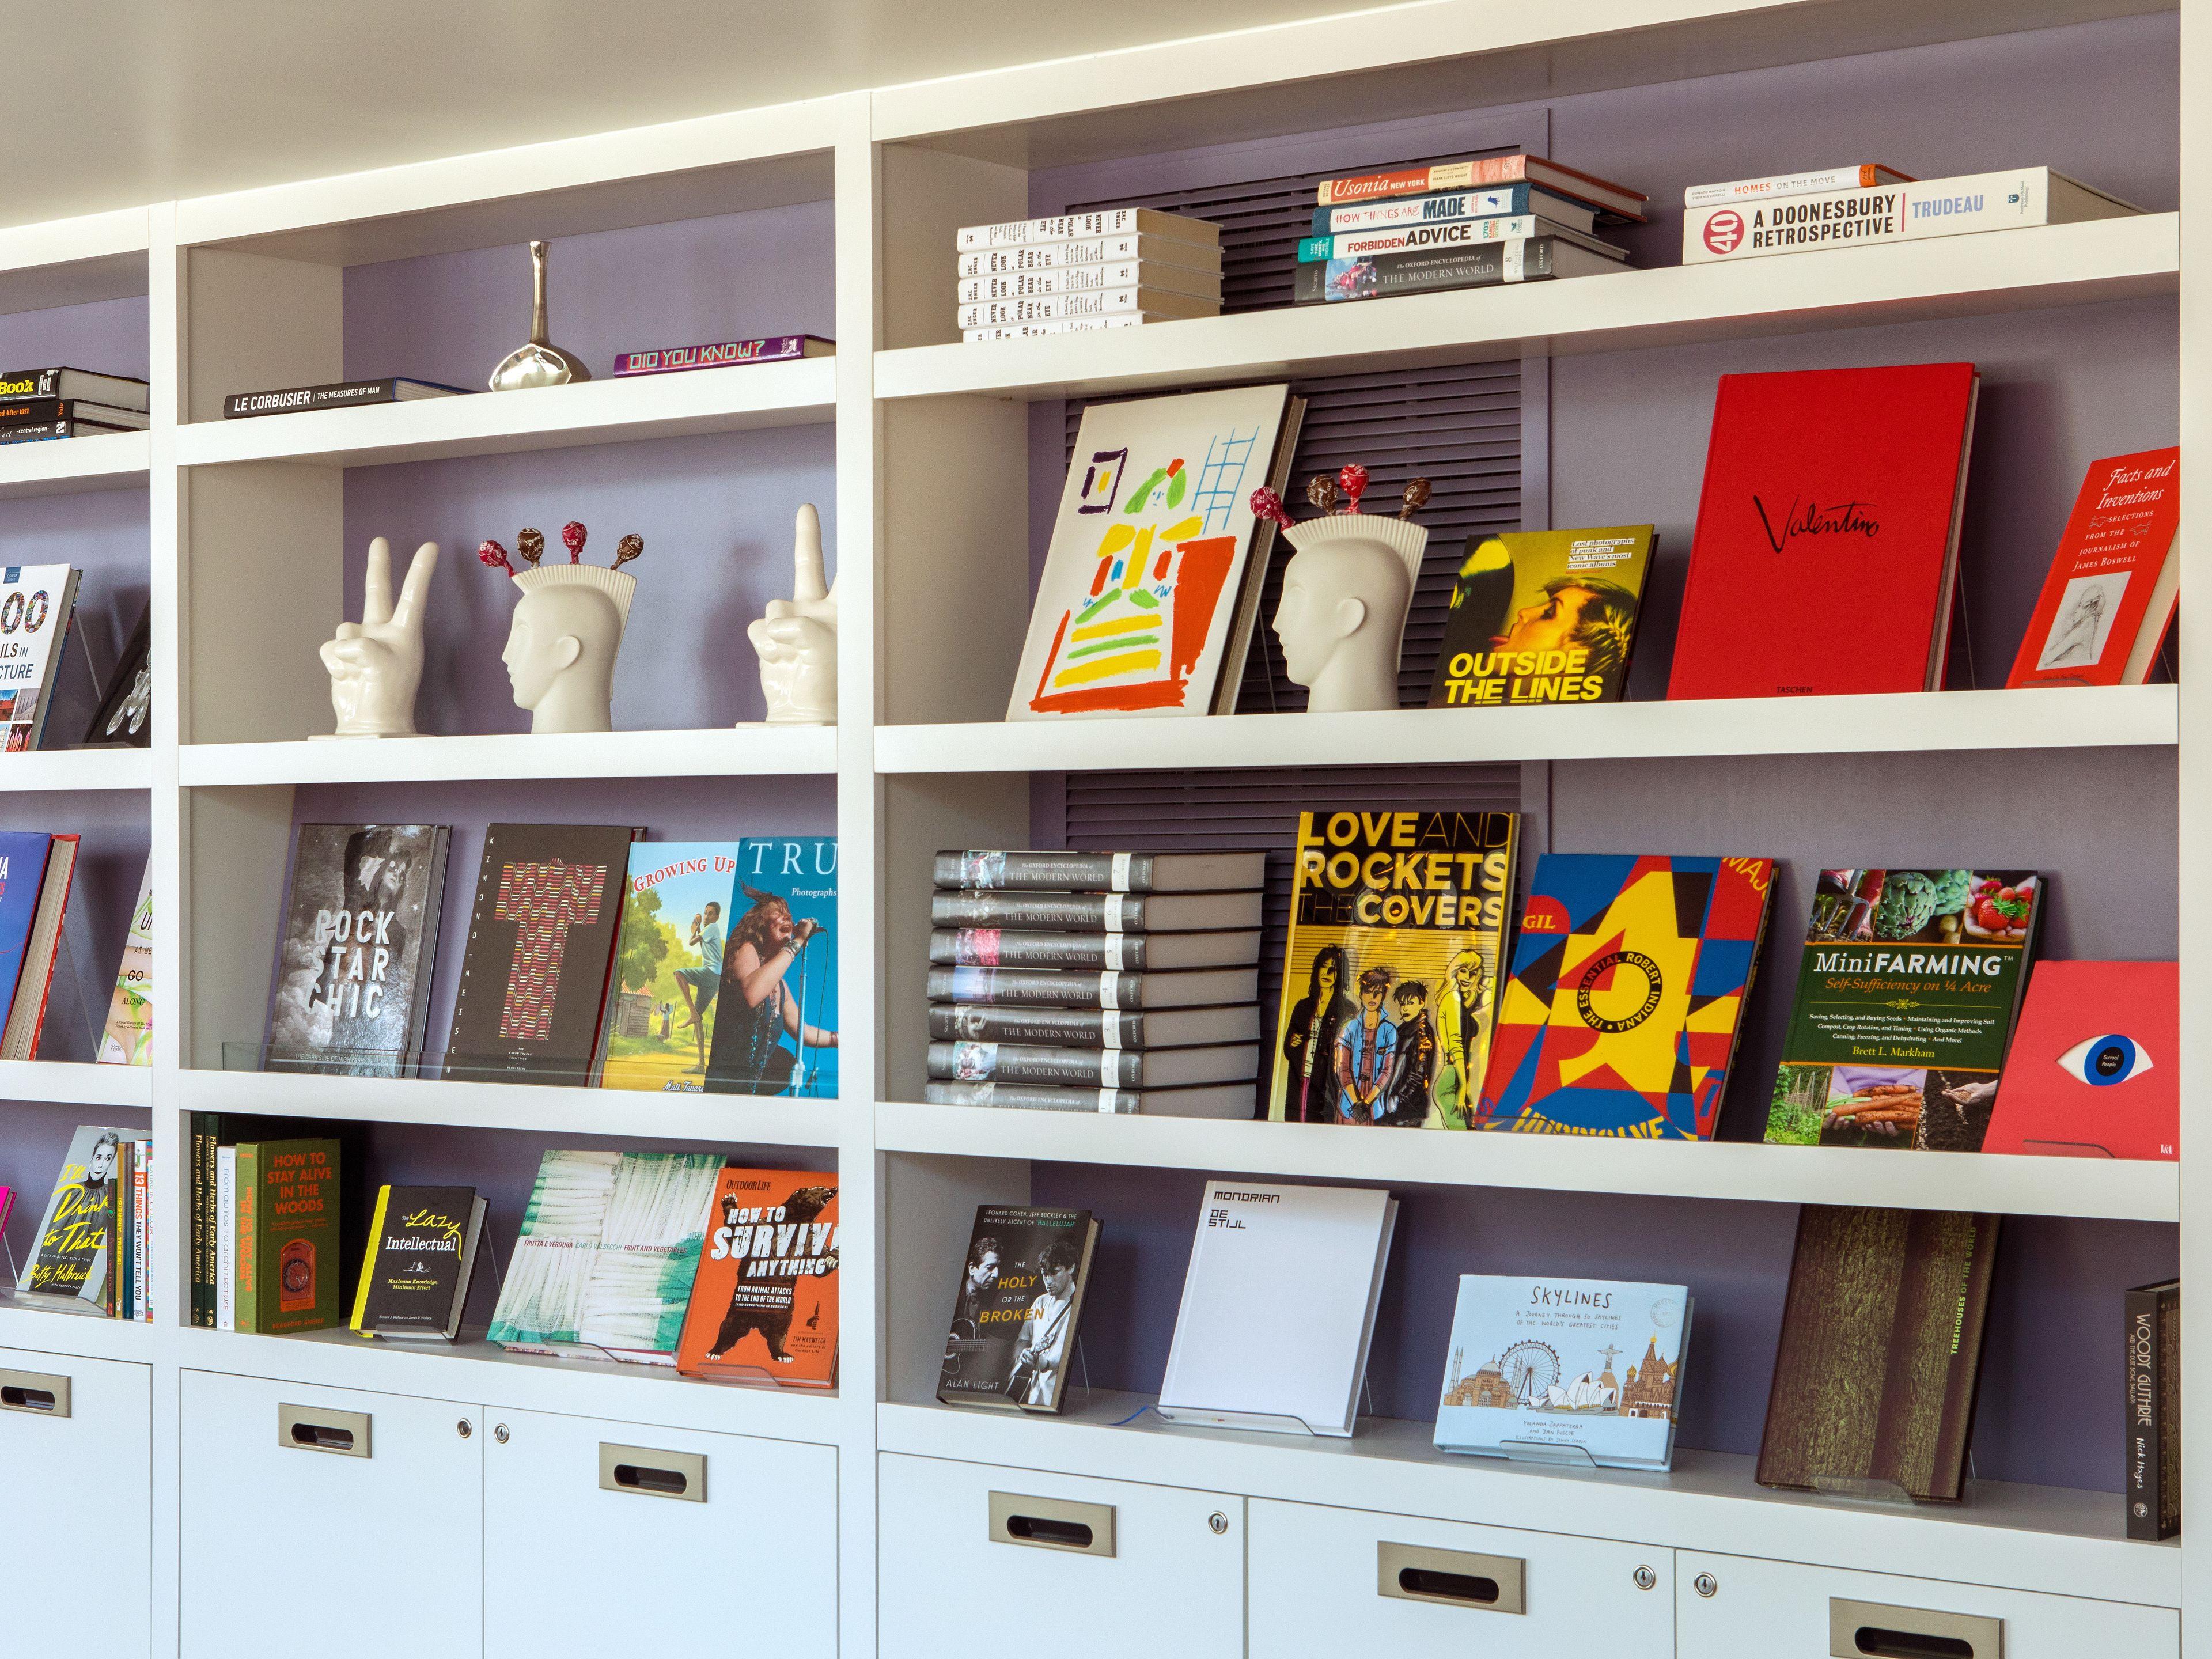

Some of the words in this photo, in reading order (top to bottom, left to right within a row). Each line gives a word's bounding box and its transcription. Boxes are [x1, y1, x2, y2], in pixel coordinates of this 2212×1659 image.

[1334, 175, 1389, 197] Usonia
[1390, 181, 1407, 190] NEW
[1408, 179, 1425, 188] YORK
[1735, 183, 1771, 195] HOMES
[1777, 181, 1789, 190] ON
[1791, 179, 1808, 188] THE
[1810, 176, 1836, 185] MOVE
[1336, 213, 1360, 224] HOW
[1364, 209, 1399, 220] THINGS
[1423, 196, 1466, 219] MADE
[1753, 210, 1764, 228] A
[1773, 194, 1896, 226] DOONESBURY
[1912, 194, 1984, 218] TRUDEAU
[1347, 237, 1405, 253] FORBIDDEN
[1405, 225, 1471, 246] ADVICE
[1710, 213, 1738, 252] 40
[1753, 216, 1893, 248] RETROSPECTIVE
[1383, 274, 1404, 285] THE
[1415, 269, 1453, 283] MODERN
[1456, 264, 1494, 278] WORLD
[630, 353, 658, 369] DID
[664, 348, 697, 365] YOU
[700, 341, 765, 362] KNOW?
[234, 397, 248, 412] LE
[251, 391, 311, 410] CORBUSIER
[317, 392, 327, 400] THE
[329, 388, 358, 399] MEASURES
[359, 388, 366, 396] OF
[368, 387, 380, 395] MAN
[2104, 467, 2143, 491] Facts
[2145, 460, 2176, 479] and
[2096, 487, 2164, 510] Inventions
[1753, 494, 1880, 553] Valentino
[2108, 510, 2153, 523] SELECTIONS
[1589, 538, 1634, 547] photographs
[2085, 532, 2106, 540] FROM
[2109, 529, 2125, 537] THE
[1580, 547, 1597, 555] punk
[2078, 543, 2127, 556] JOURNALISM
[19, 647, 29, 657] IN
[1449, 649, 1589, 677] OUTSIDE
[1445, 679, 1506, 704] THE
[1510, 675, 1603, 703] LINES
[1301, 812, 1419, 847] LOVE
[1418, 812, 1512, 848] AND
[634, 858, 707, 892] GROWING
[1301, 851, 1508, 891] ROCKETS
[791, 887, 837, 897] Photographs
[1298, 893, 1355, 922] THE
[1355, 895, 1504, 929] COVERS
[315, 909, 395, 944] ROCK
[1522, 915, 1556, 930] GIL
[312, 946, 389, 982] STAR
[1626, 952, 1661, 987] ROBERT
[128, 970, 143, 982] GO
[1578, 953, 1621, 1008] ESSENTIAL
[1825, 978, 1919, 993] Self-Sufficiency
[1924, 983, 1939, 991] on
[1960, 982, 1991, 993] Acre
[121, 997, 145, 1006] ALONG
[306, 983, 384, 1019] CHIC
[1618, 990, 1661, 1031] INDIANA
[1583, 1005, 1604, 1031] THE
[1853, 1046, 1875, 1056] Brett
[1878, 1047, 1887, 1056] L.
[1891, 1047, 1934, 1058] Markham
[274, 1154, 307, 1168] HOW
[310, 1152, 326, 1165] TO
[135, 1174, 144, 1185] 13
[267, 1169, 296, 1184] STAY
[299, 1167, 332, 1181] ALIVE
[280, 1185, 294, 1199] IN
[297, 1184, 319, 1197] THE
[1214, 1191, 1280, 1204] MONDRIAN
[135, 1188, 143, 1219] THINGS
[274, 1199, 324, 1215] WOODS
[1210, 1210, 1228, 1218] DE
[209, 1218, 217, 1229] of
[728, 1207, 763, 1225] HOW
[766, 1206, 787, 1222] TO
[1209, 1219, 1246, 1229] STIJL
[43, 1228, 65, 1247] to
[60, 1222, 107, 1253] That
[209, 1229, 217, 1248] Early
[386, 1236, 456, 1251] Intellectual
[406, 1209, 462, 1260] Lazy
[1966, 1226, 1976, 1258] WORLD
[747, 1258, 827, 1278] ANYTHING
[1963, 1260, 1971, 1279] THE
[751, 1286, 770, 1294] ANIMAL
[771, 1287, 793, 1295] ATTACKS
[998, 1275, 1037, 1290] HOLY
[1960, 1282, 1968, 1293] OF
[1531, 1286, 1612, 1309] SKYLINES
[979, 1308, 1045, 1324] BROKEN
[1950, 1296, 1965, 1355] TREEHOUSES
[2137, 1313, 2151, 1369] WOODY
[946, 1379, 969, 1388] ALAN
[973, 1381, 999, 1390] LIGHT
[2137, 1374, 2152, 1427] GUTHRIE
[2136, 1437, 2146, 1459] Nick
[2134, 1461, 2145, 1489] Hayes
